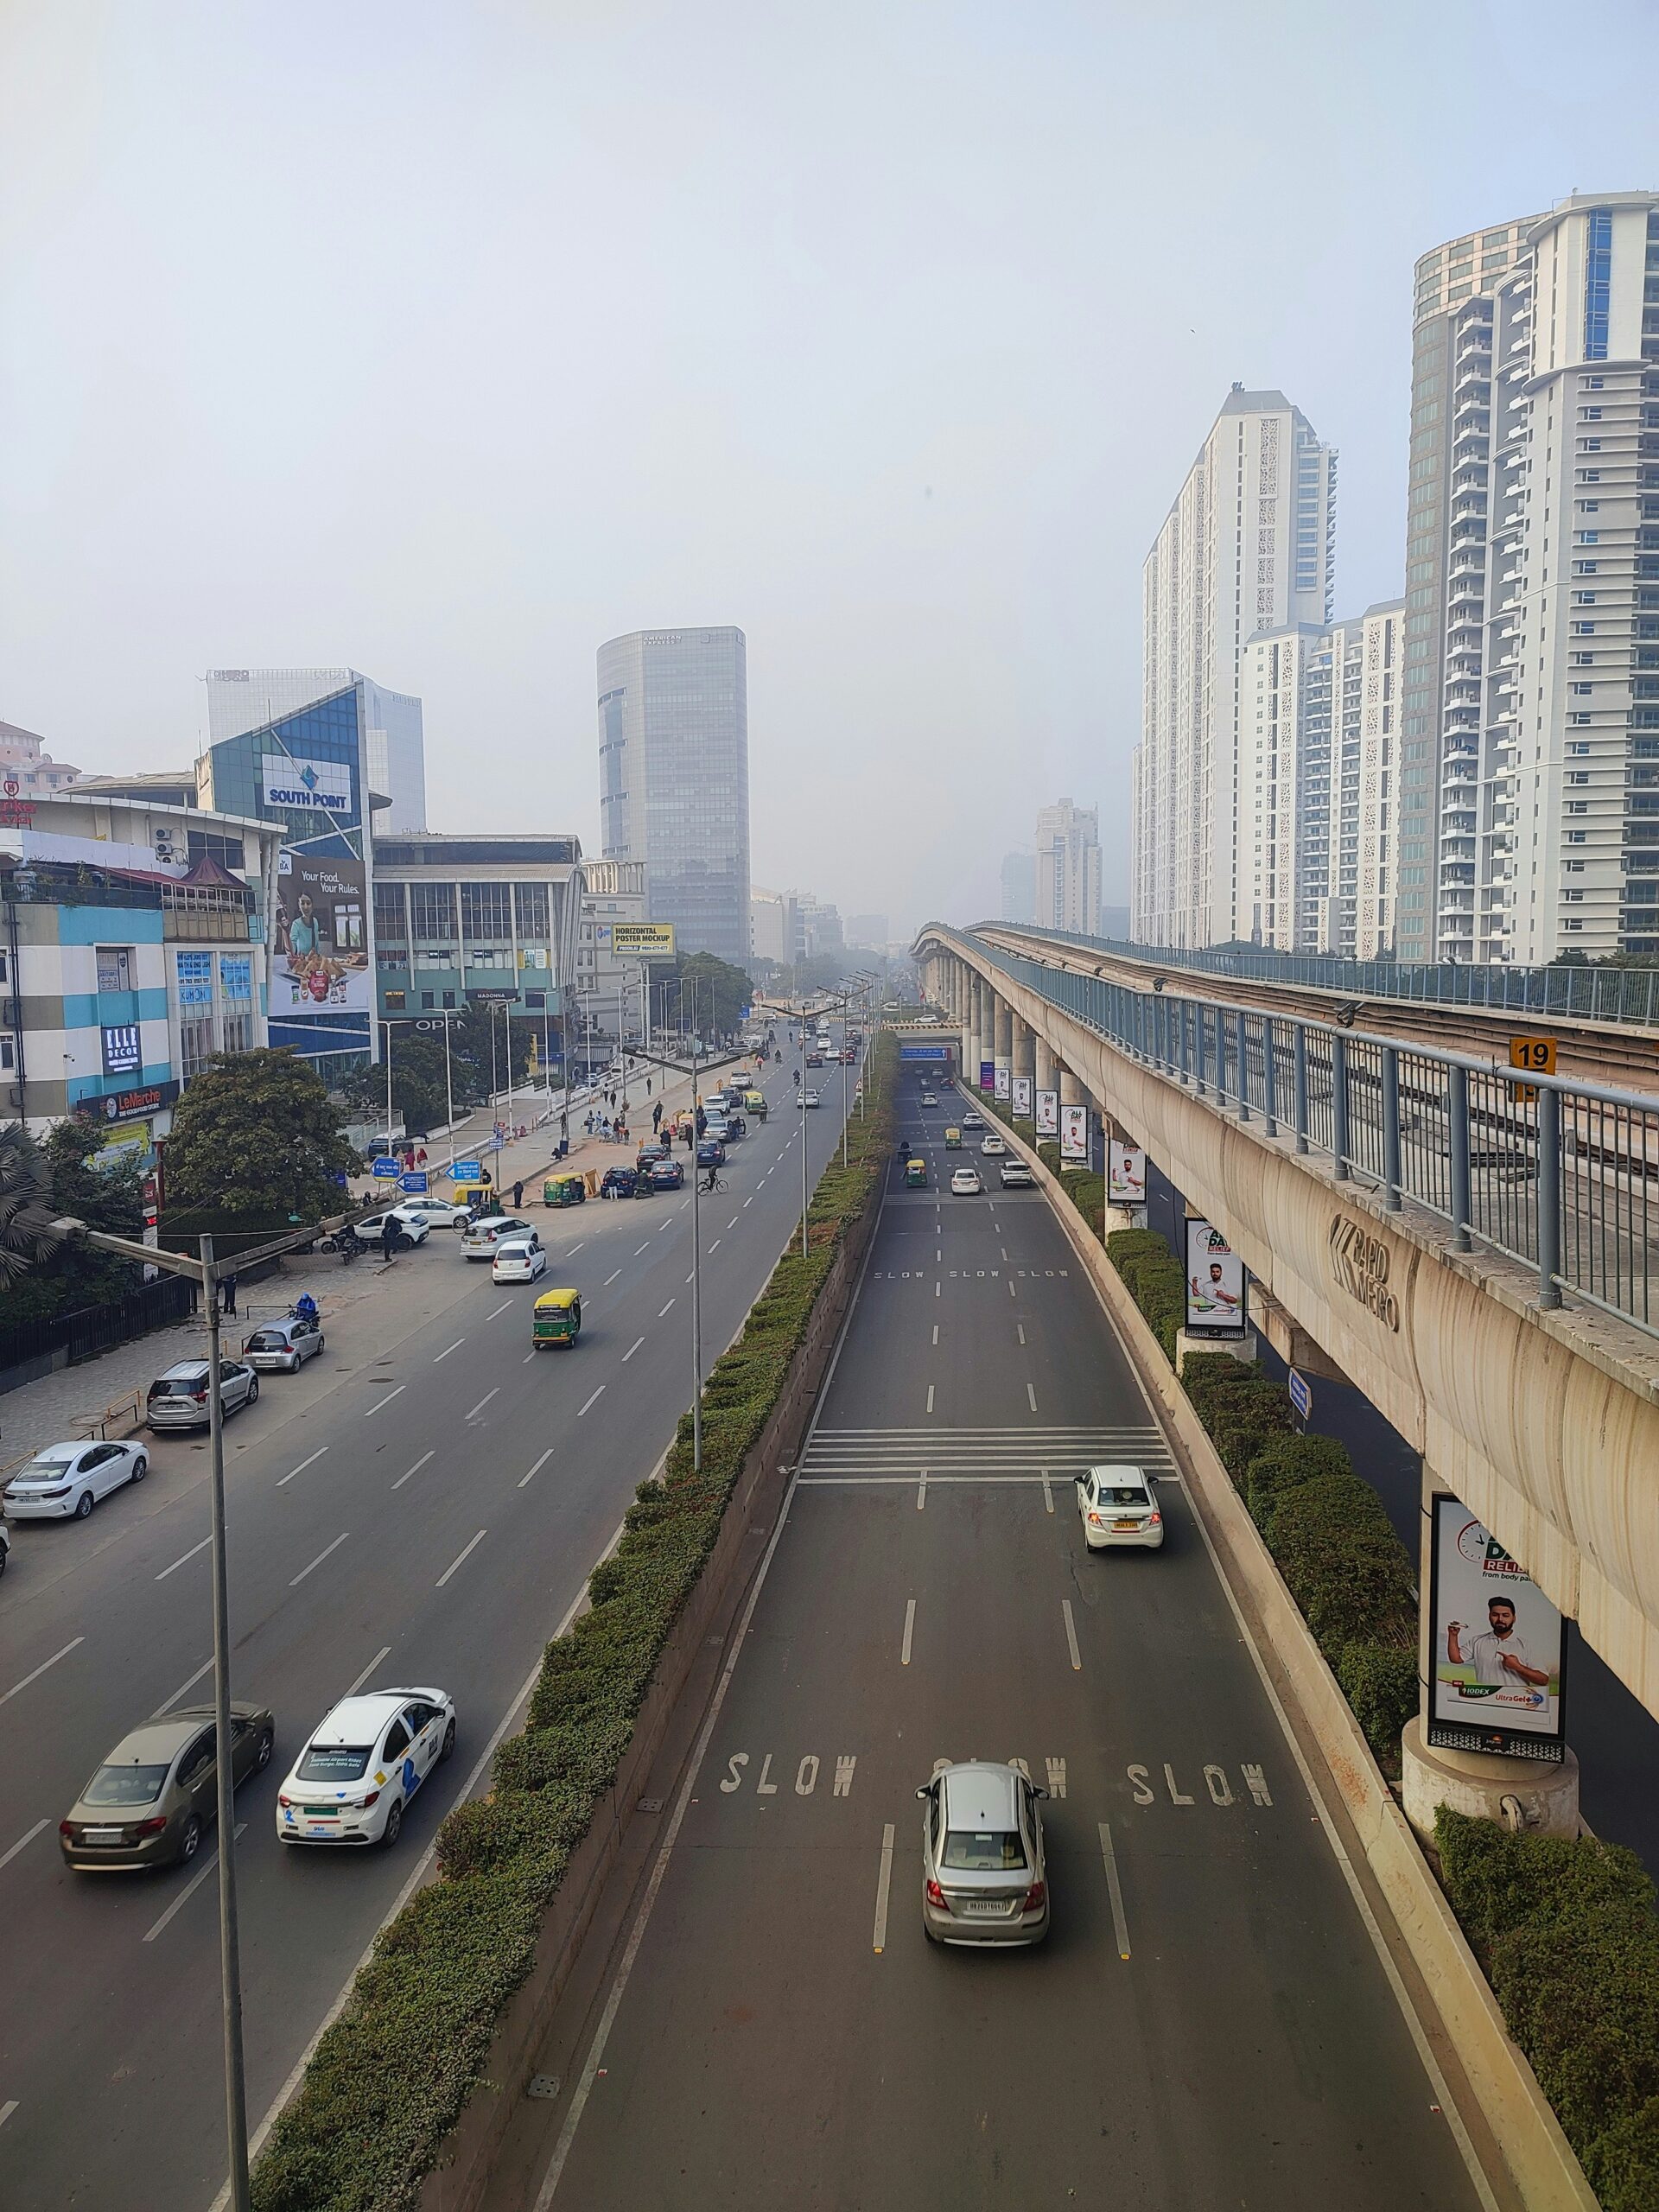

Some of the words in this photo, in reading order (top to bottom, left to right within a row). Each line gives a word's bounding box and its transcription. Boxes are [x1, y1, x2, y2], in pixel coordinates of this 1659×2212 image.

[270, 789, 311, 805] SOUTH
[313, 792, 347, 809] POINT
[301, 870, 319, 881] Your
[319, 872, 340, 883] Food.
[320, 882, 338, 893] Your
[338, 883, 359, 894] Rules.
[181, 988, 206, 1001] KUMON
[106, 1027, 137, 1049] ELLE
[108, 1046, 137, 1058] DECOR
[1519, 1043, 1549, 1066] 19
[1353, 1228, 1391, 1284] RAPID
[1358, 1270, 1400, 1333] METRO
[1500, 1572, 1519, 1582] body
[719, 1752, 857, 1796] SLOW
[1127, 1764, 1274, 1807] SLOW
